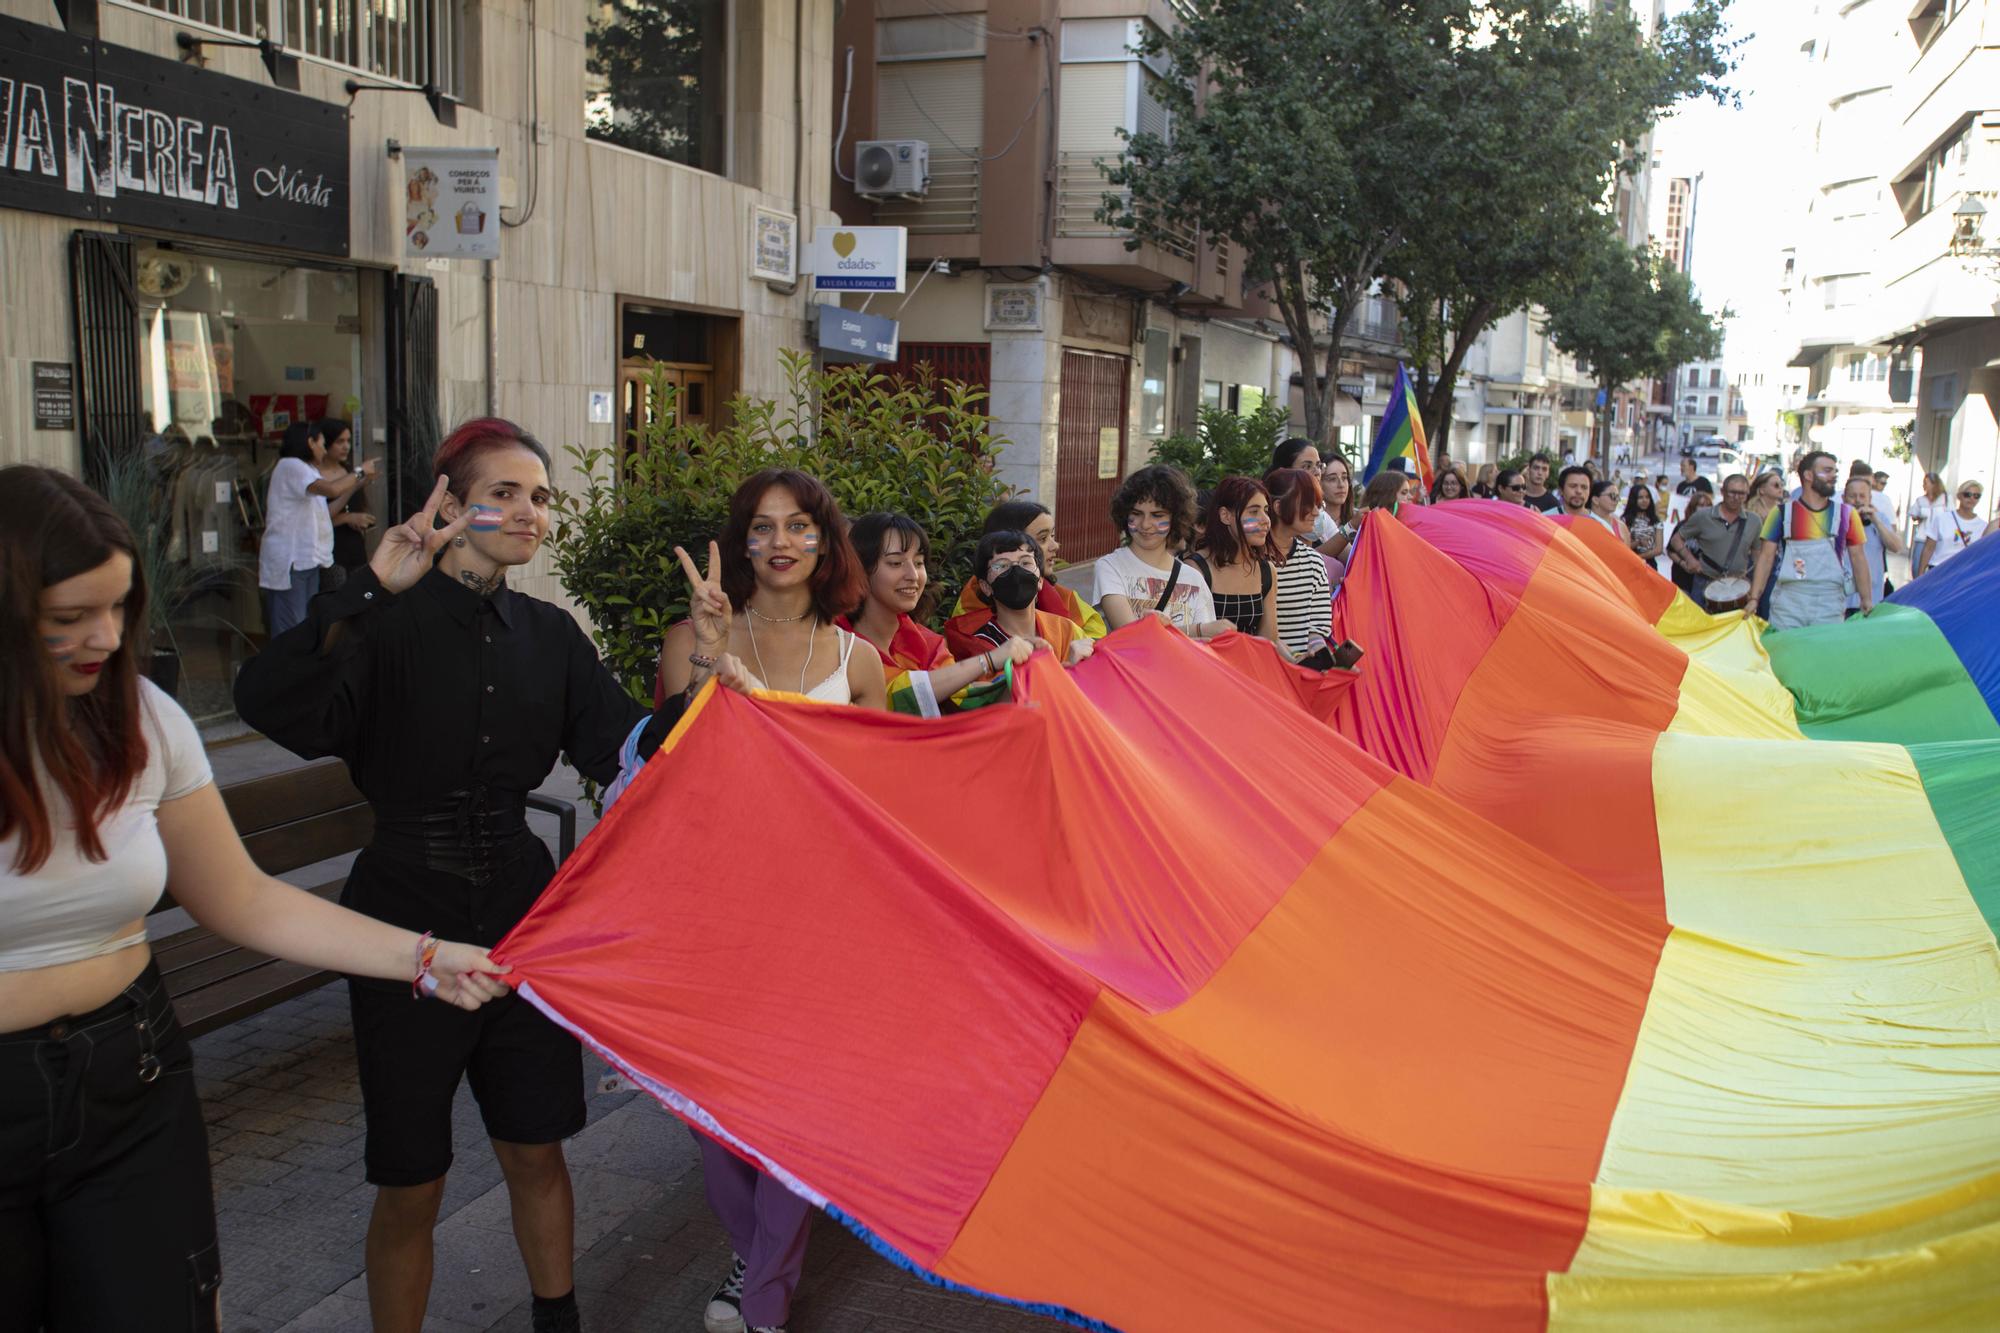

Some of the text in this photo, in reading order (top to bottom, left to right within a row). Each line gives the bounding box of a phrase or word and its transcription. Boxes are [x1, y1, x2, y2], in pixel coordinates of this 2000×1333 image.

[64, 76, 239, 210] NEREA
[254, 164, 333, 208] Moda
[448, 170, 490, 179] COMERÇOS
[838, 258, 876, 270] edades
[821, 279, 848, 288] AYUDA
[855, 279, 895, 288] DOMICILIO
